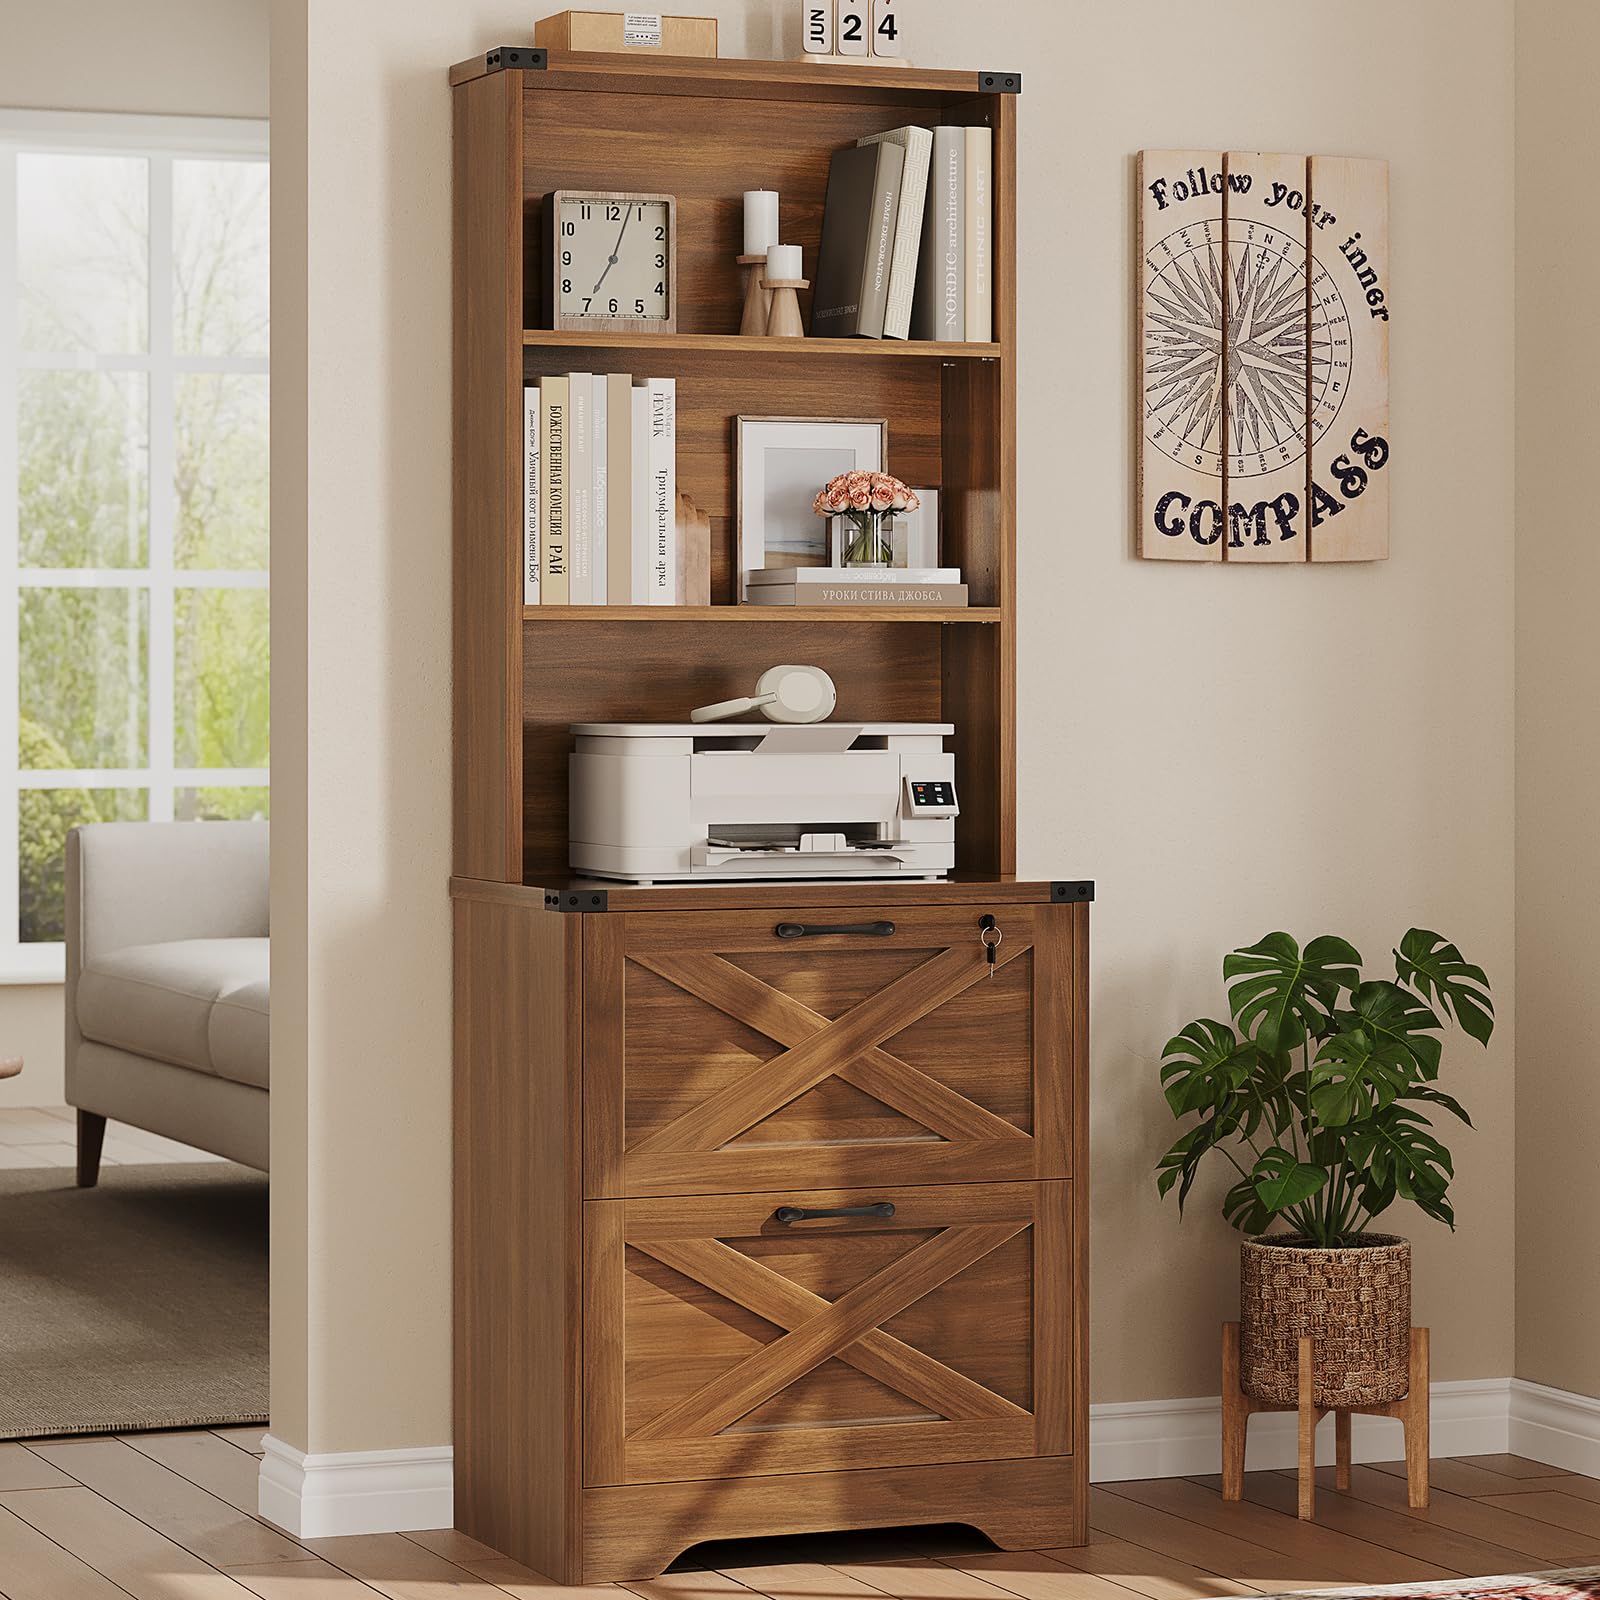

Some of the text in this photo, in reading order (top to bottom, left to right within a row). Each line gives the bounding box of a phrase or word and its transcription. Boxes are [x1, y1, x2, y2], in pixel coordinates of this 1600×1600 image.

[810, 10, 898, 44] JUN 2 4
[581, 205, 591, 220] 11
[606, 206, 621, 221] 12
[638, 207, 642, 222] 1
[561, 221, 575, 236] 10
[654, 226, 665, 241] 2
[976, 165, 985, 294] ETHNIC ART
[875, 192, 893, 292] HOME DECORATION
[945, 148, 958, 326] NORDIC architecture
[1148, 166, 1390, 322] Follow your inner
[1264, 233, 1274, 245] N
[562, 251, 571, 266] 9
[654, 254, 665, 268] 3
[562, 279, 572, 293] 8
[654, 282, 665, 296] 4
[582, 298, 592, 312] 7
[609, 299, 618, 313] 6
[635, 299, 644, 313] 5
[1332, 381, 1341, 393] E
[1194, 454, 1203, 466] S
[529, 451, 539, 495] Уличный
[548, 405, 567, 575] БОЖЕСТВЕННАЯ КОМЕДИЯ РАЙ
[1154, 426, 1390, 548] COMPASS
[529, 516, 536, 529] по
[655, 468, 669, 587] Триумфальная арка
[529, 563, 539, 583] Боб
[822, 590, 943, 601] УРОКИ СТИВА ДЖОБСА
